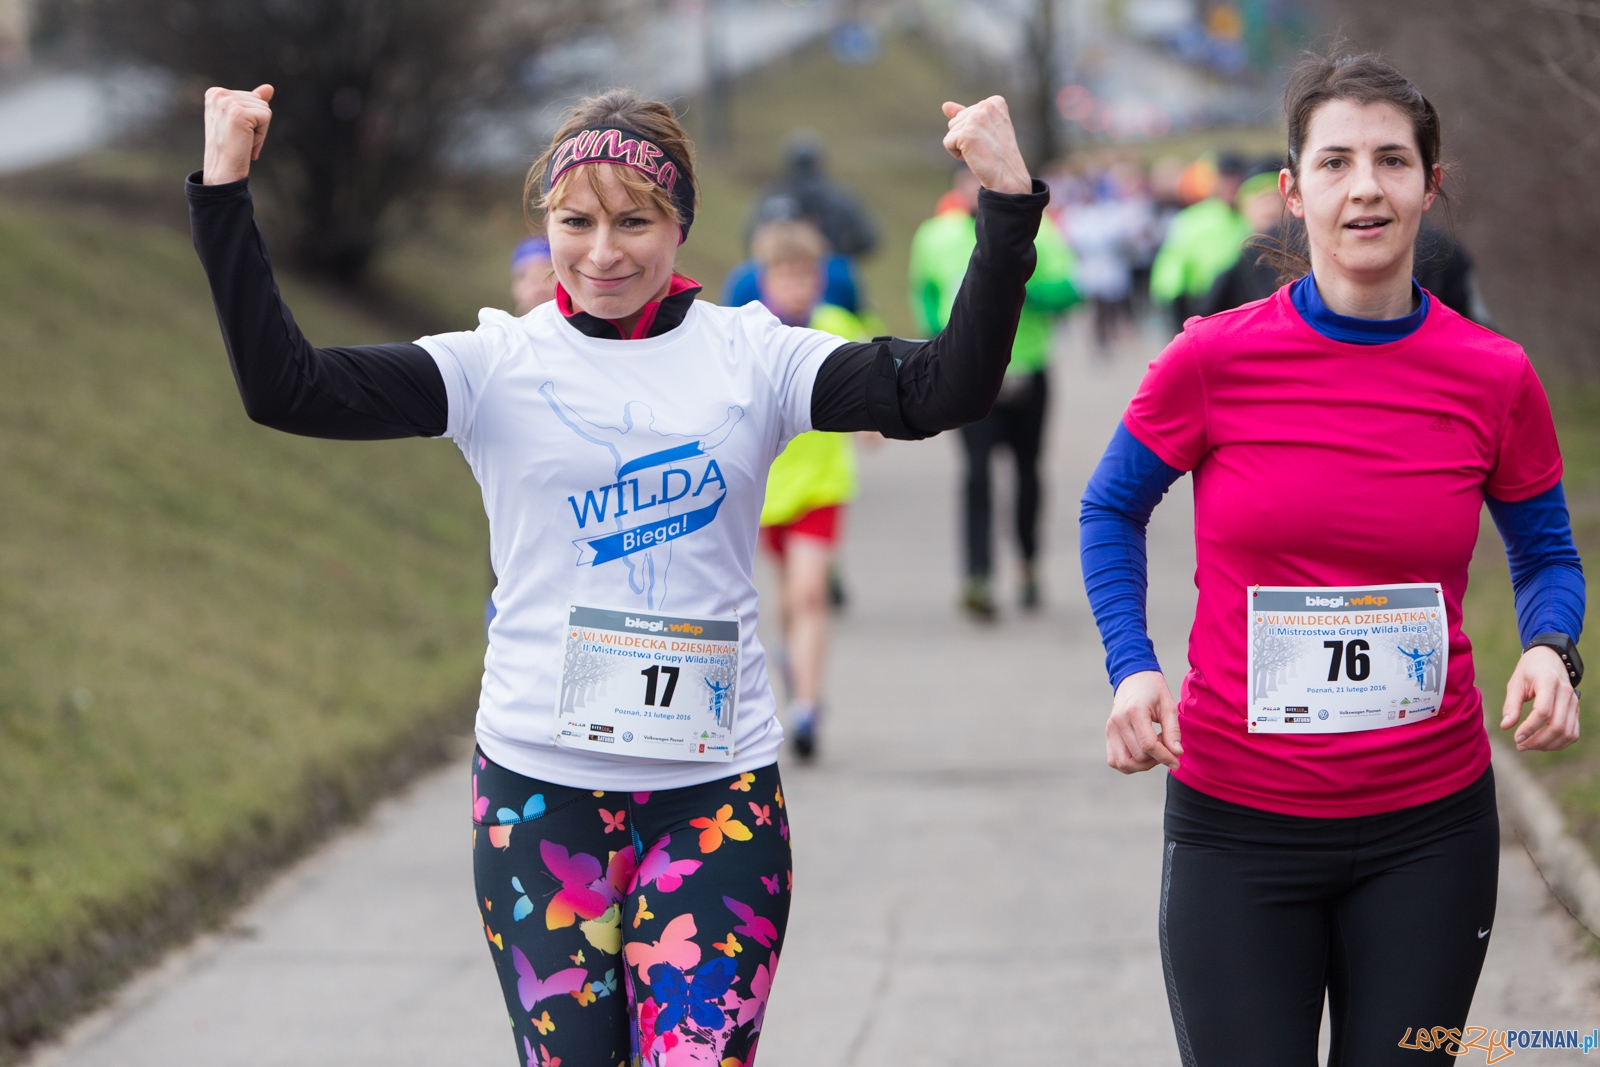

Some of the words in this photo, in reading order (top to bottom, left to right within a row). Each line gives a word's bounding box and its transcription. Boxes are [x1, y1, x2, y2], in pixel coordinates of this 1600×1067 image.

[551, 129, 677, 199] ZUMBA
[567, 459, 727, 529] WILDA
[622, 514, 688, 552] Biega!
[1267, 616, 1279, 625] VI
[1283, 615, 1351, 626] WILDECKA
[1354, 611, 1427, 625] DZIESIĄTKA
[1268, 627, 1275, 636] II
[1277, 627, 1336, 636] Mistrzostwa
[1338, 627, 1369, 637] Grupy
[1371, 625, 1399, 635] Wilda
[1402, 625, 1428, 635] Biega
[582, 632, 596, 642] VI
[599, 633, 667, 650] WILDECKA
[671, 641, 729, 656] DZIESIĄTKA
[582, 643, 589, 652] II
[591, 645, 651, 660] Mistrzostwa
[654, 652, 683, 664] Grupy
[685, 655, 708, 664] Wilda
[709, 657, 729, 666] Biega
[1323, 639, 1371, 682] 76
[641, 664, 680, 708] 17
[1306, 686, 1334, 694] Poznań,
[1346, 686, 1368, 694] lutego
[1370, 684, 1387, 692] 2016
[614, 707, 642, 717] Poznań,
[653, 711, 675, 720] lutego
[675, 713, 692, 721] 2016
